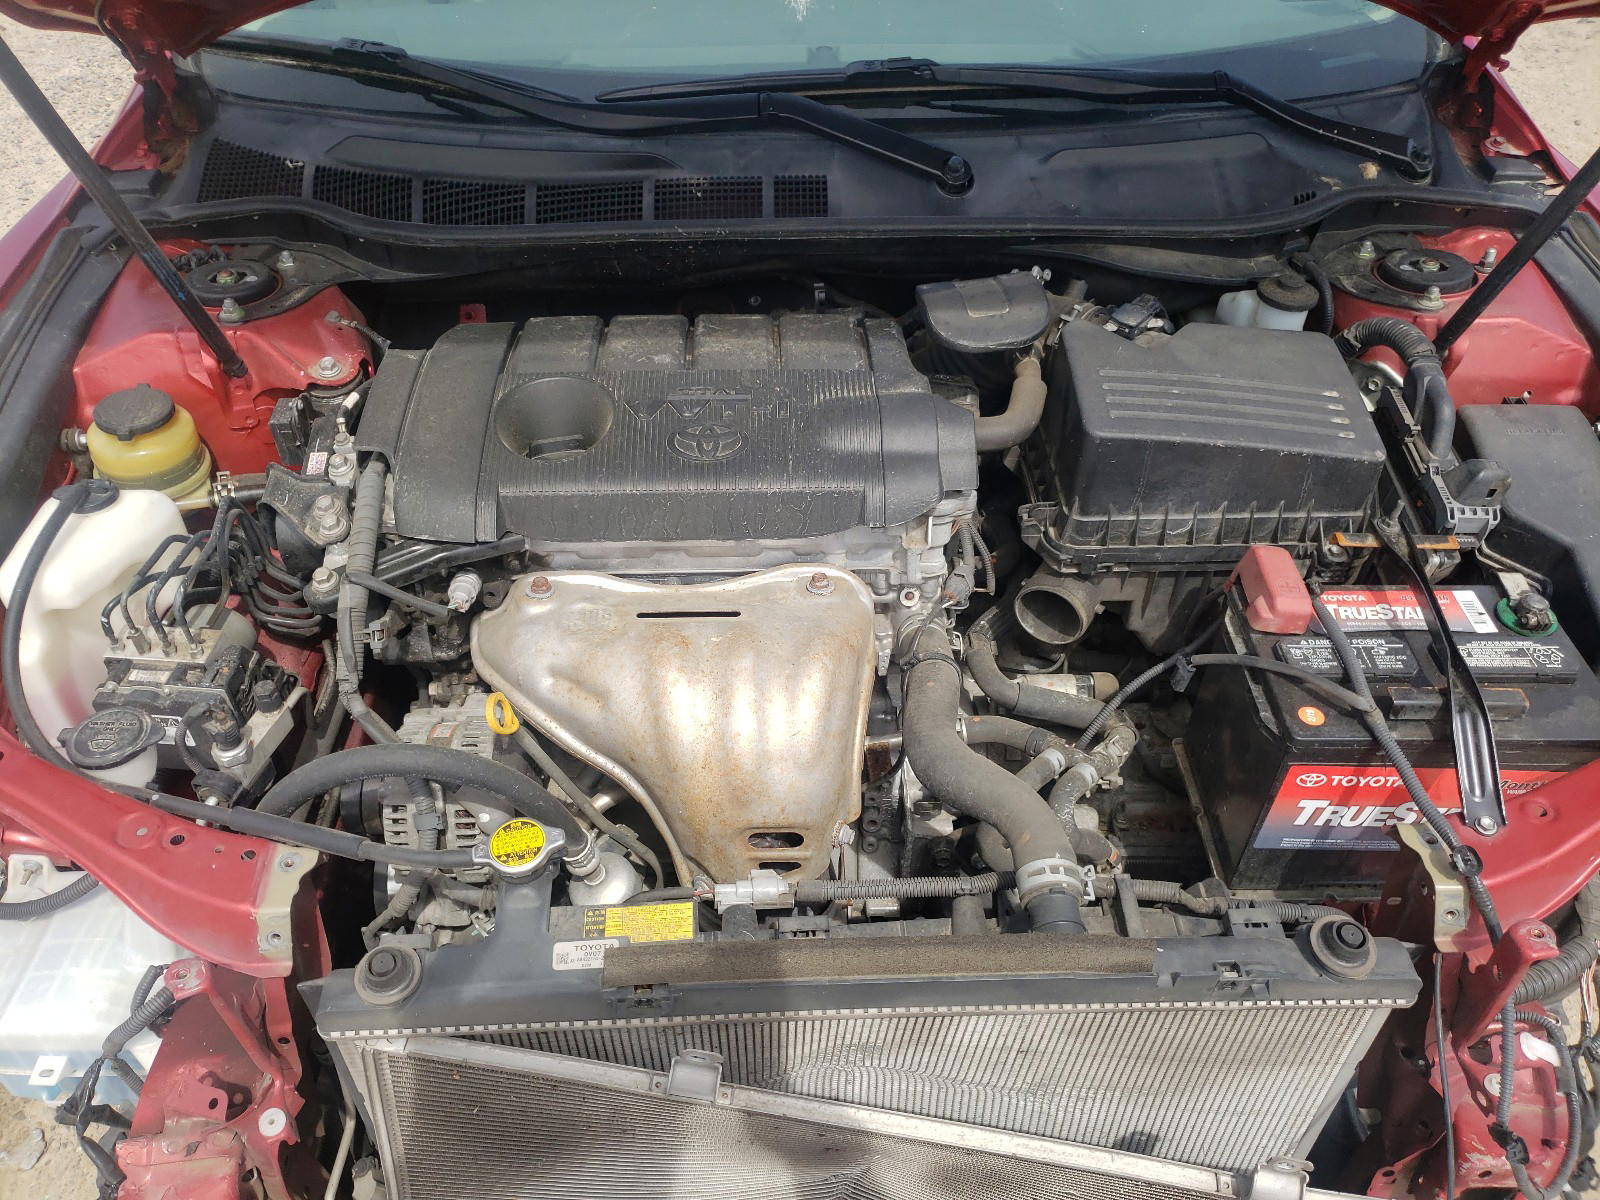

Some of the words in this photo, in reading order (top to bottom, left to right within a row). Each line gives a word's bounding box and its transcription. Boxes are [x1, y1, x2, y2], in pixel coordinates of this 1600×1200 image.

[1322, 594, 1367, 602] TOYOTA
[1325, 603, 1446, 620] TRUESTA
[1293, 800, 1464, 828] TRUES
[573, 943, 615, 952] TOYOTA
